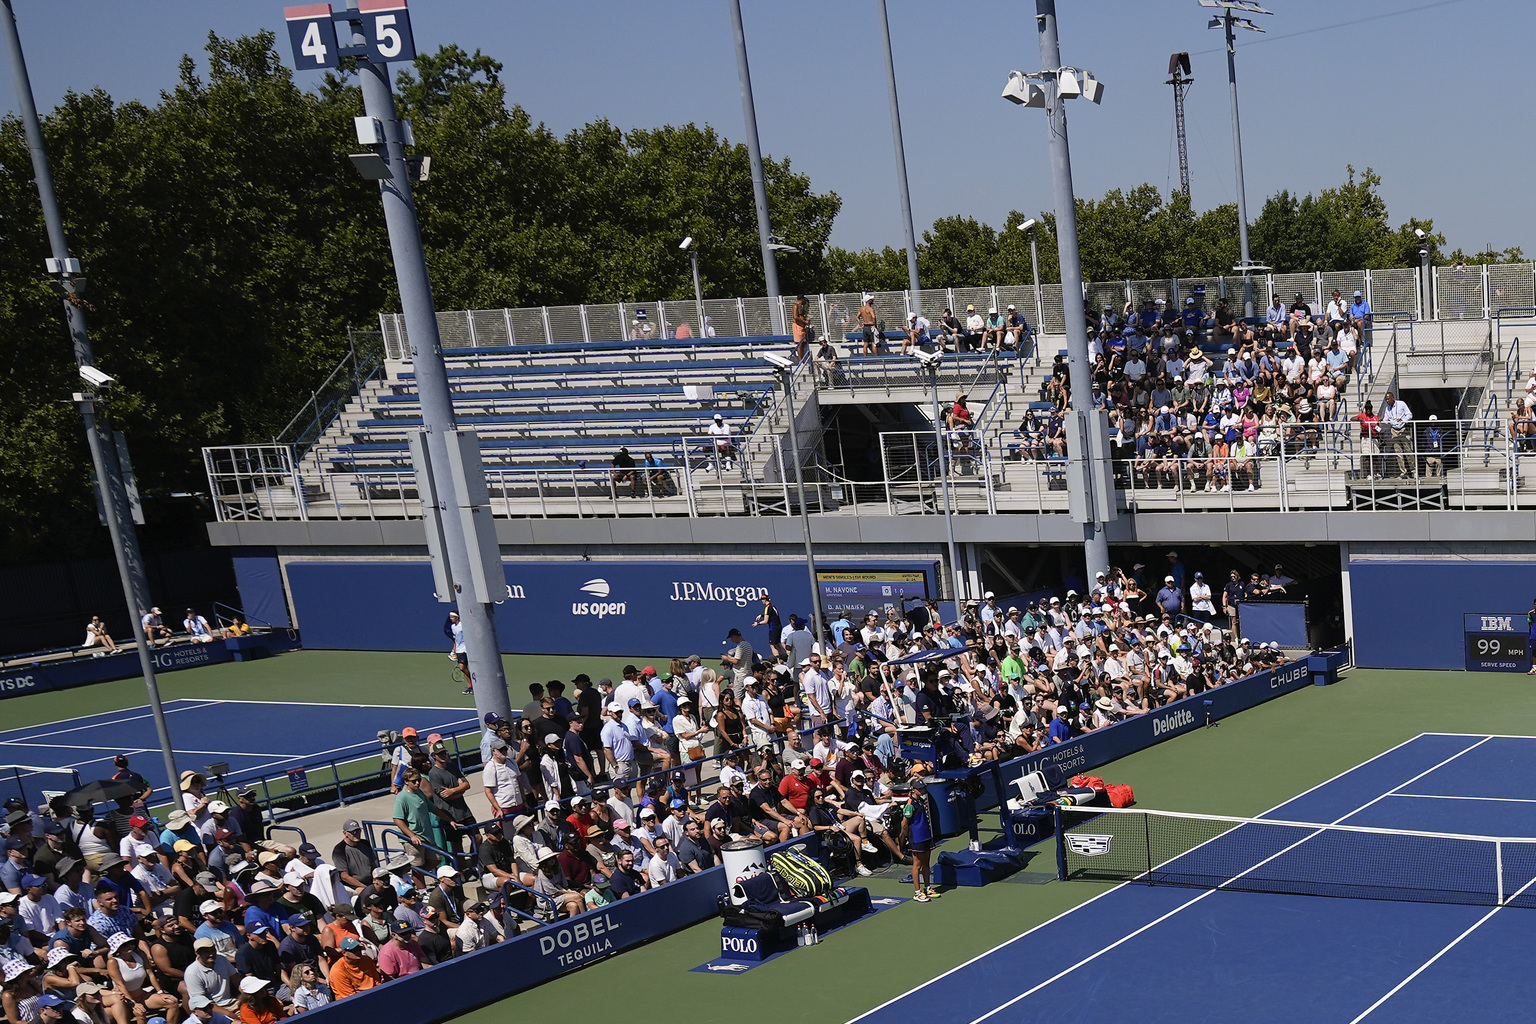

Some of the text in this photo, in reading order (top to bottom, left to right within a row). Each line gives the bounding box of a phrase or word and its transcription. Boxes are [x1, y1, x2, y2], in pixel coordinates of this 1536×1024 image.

[301, 22, 327, 64] 4
[375, 14, 401, 58] 5
[670, 582, 769, 607] J.P.Morgan
[572, 601, 626, 618] us open
[1481, 616, 1514, 631] IBM
[1477, 639, 1500, 655] 99
[175, 653, 209, 665] RESORTS
[1270, 665, 1308, 689] CHUBB
[1153, 709, 1195, 736] Deloitte.
[1052, 749, 1079, 763] HOTELS
[1056, 756, 1086, 773] ESORTS
[1010, 823, 1036, 835] OLO
[539, 913, 620, 956] DOBEL
[557, 938, 613, 967] TEQUILA
[721, 936, 758, 953] POLO
